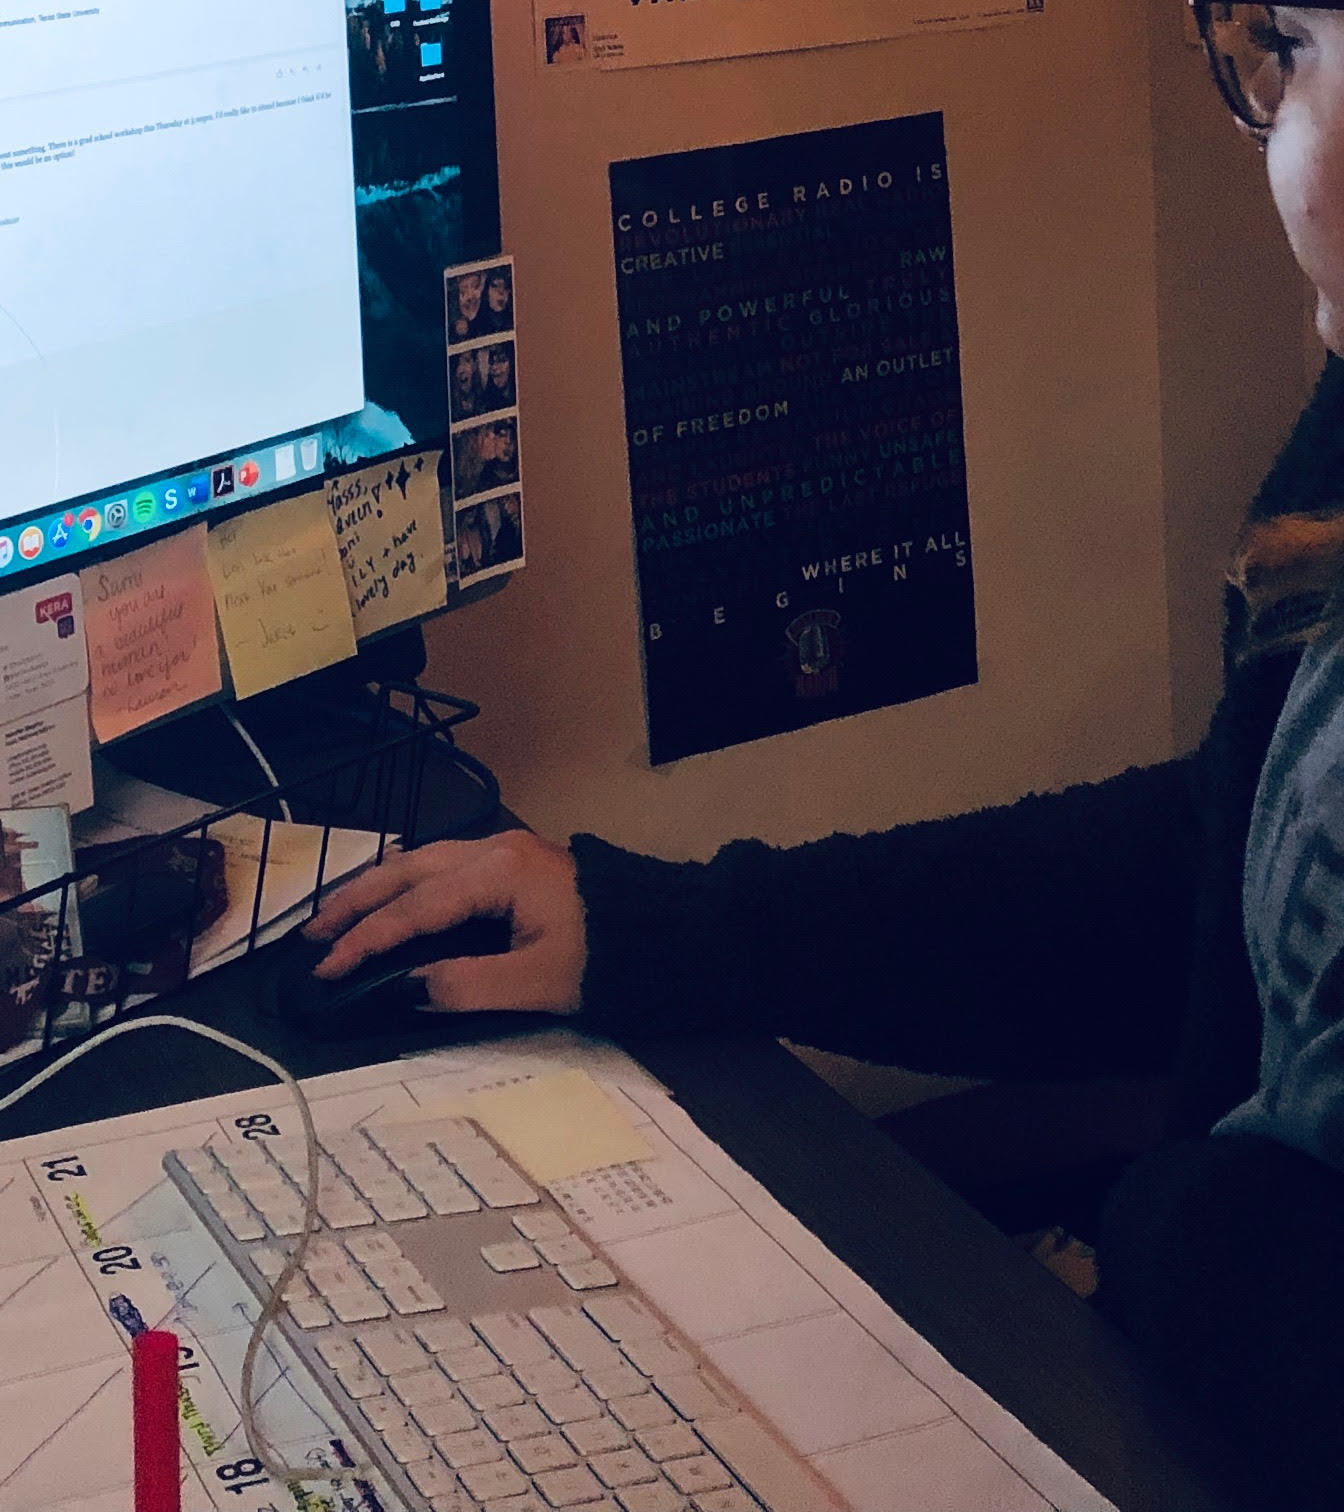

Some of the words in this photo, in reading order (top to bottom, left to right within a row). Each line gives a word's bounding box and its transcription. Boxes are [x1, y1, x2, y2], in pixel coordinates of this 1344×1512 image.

[618, 191, 770, 232] COLLEGE
[794, 170, 893, 204] RADIO
[915, 162, 944, 183] IS
[620, 242, 724, 276] CREATIVE
[899, 245, 948, 269] RAW
[626, 314, 682, 340] AND
[698, 285, 851, 327] POWERFUL
[841, 363, 869, 385] AN
[875, 348, 955, 378] OUTLET
[632, 425, 665, 447] OF
[676, 399, 789, 439] FREEDOM
[801, 548, 884, 582] WHERE
[893, 540, 915, 560] IT
[924, 531, 967, 554] ALL
[39, 595, 71, 618] KERA
[234, 1112, 282, 1142] 28
[41, 1154, 88, 1183] 21
[92, 1245, 143, 1276] 20
[215, 1456, 270, 1496] 18
